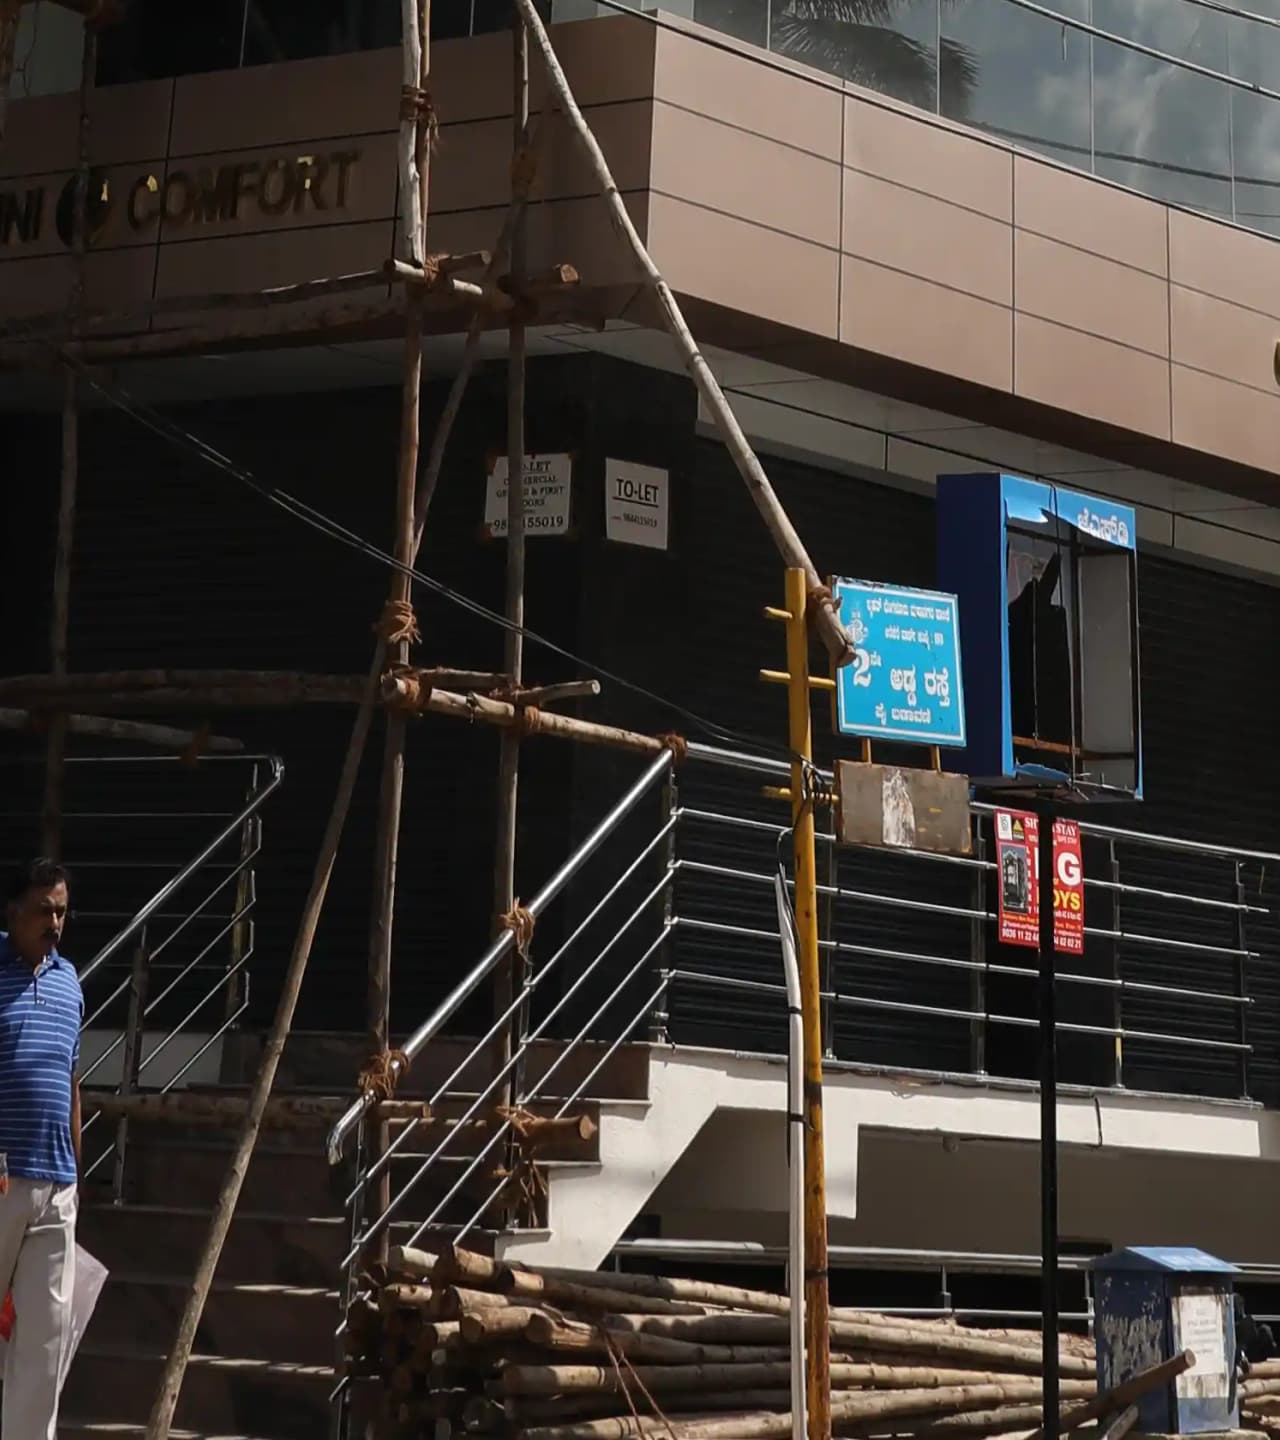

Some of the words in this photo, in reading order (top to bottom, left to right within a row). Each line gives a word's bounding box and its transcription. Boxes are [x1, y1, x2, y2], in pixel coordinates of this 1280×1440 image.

[127, 151, 362, 231] COMFORT
[615, 478, 660, 504] TO-LET
[494, 516, 564, 530] 98155019
[1055, 822, 1077, 837] STAY
